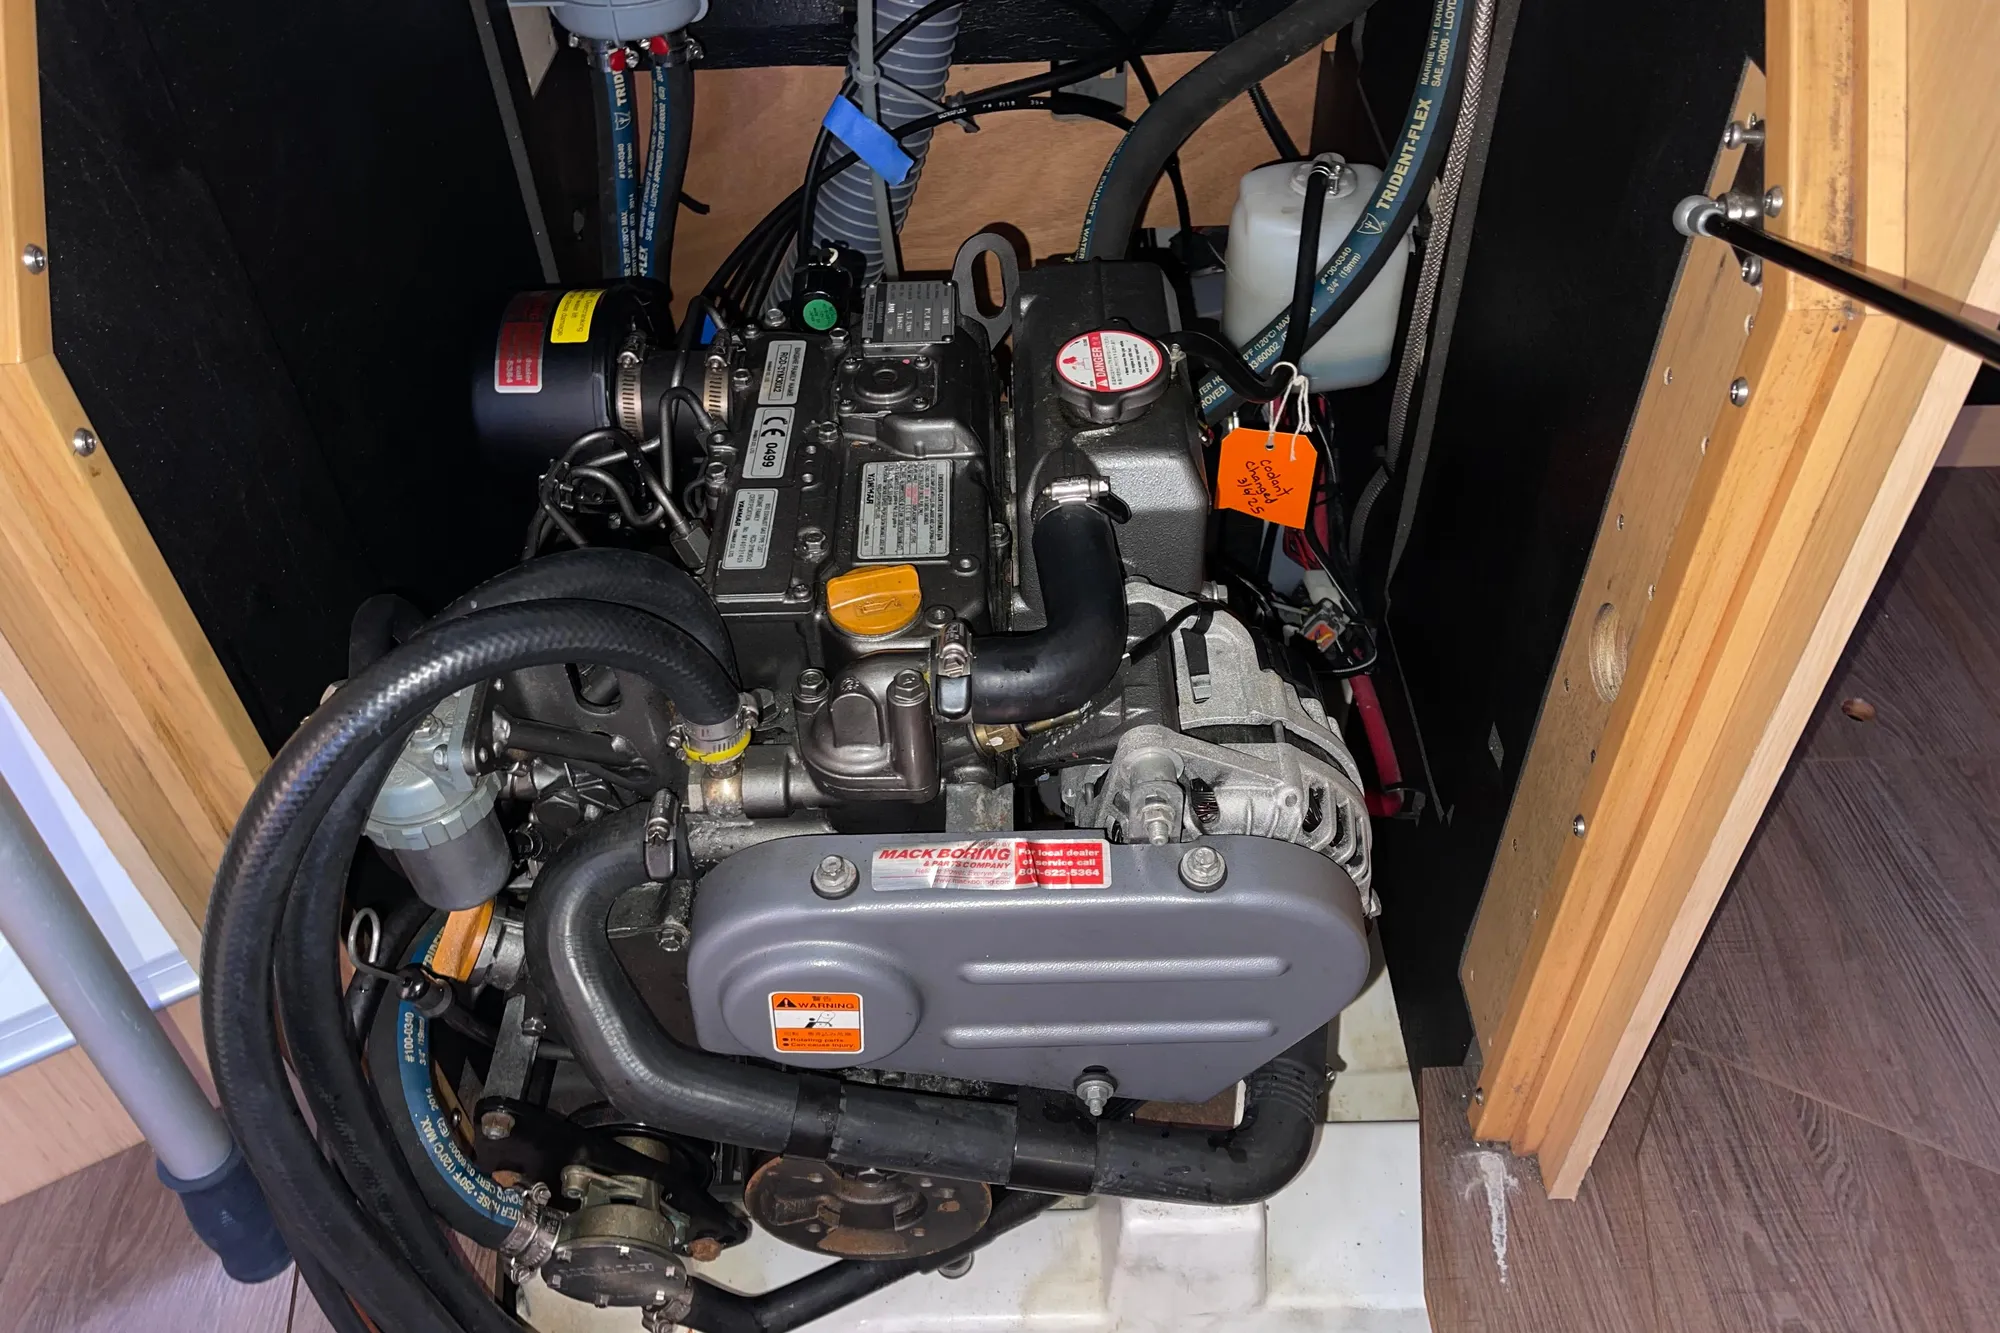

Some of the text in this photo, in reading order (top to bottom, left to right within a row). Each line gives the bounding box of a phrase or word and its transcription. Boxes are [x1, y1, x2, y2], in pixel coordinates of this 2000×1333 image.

[1421, 51, 1434, 86] MARINE
[1430, 30, 1440, 48] WET
[612, 70, 627, 106] TRID
[1431, 67, 1444, 88] SAE
[1376, 98, 1432, 210] TRIDENT-FLEX
[1088, 175, 1107, 216] EXHAUST
[1079, 228, 1090, 260] WATER
[1338, 253, 1362, 279] (19mm)
[1254, 330, 1277, 350] (120°C)
[1092, 347, 1105, 376] DANGER
[760, 442, 778, 467] 0499
[865, 472, 875, 504] YANMAR
[734, 500, 744, 526] YANMAR
[744, 494, 755, 520] CERTIFICATION
[879, 848, 1010, 860] MACK BORING
[1018, 848, 1100, 857] For local dealer
[1018, 868, 1100, 877] 800-622-5364
[404, 1012, 414, 1063] #100-0340
[426, 1087, 439, 1112] 2014
[420, 1115, 438, 1144] MAX.
[436, 1117, 450, 1138] (E2)
[432, 1142, 456, 1174] (120°C)
[448, 1140, 476, 1176] 03/60002
[453, 1172, 476, 1195] 250°F
[474, 1173, 496, 1194] CERT
